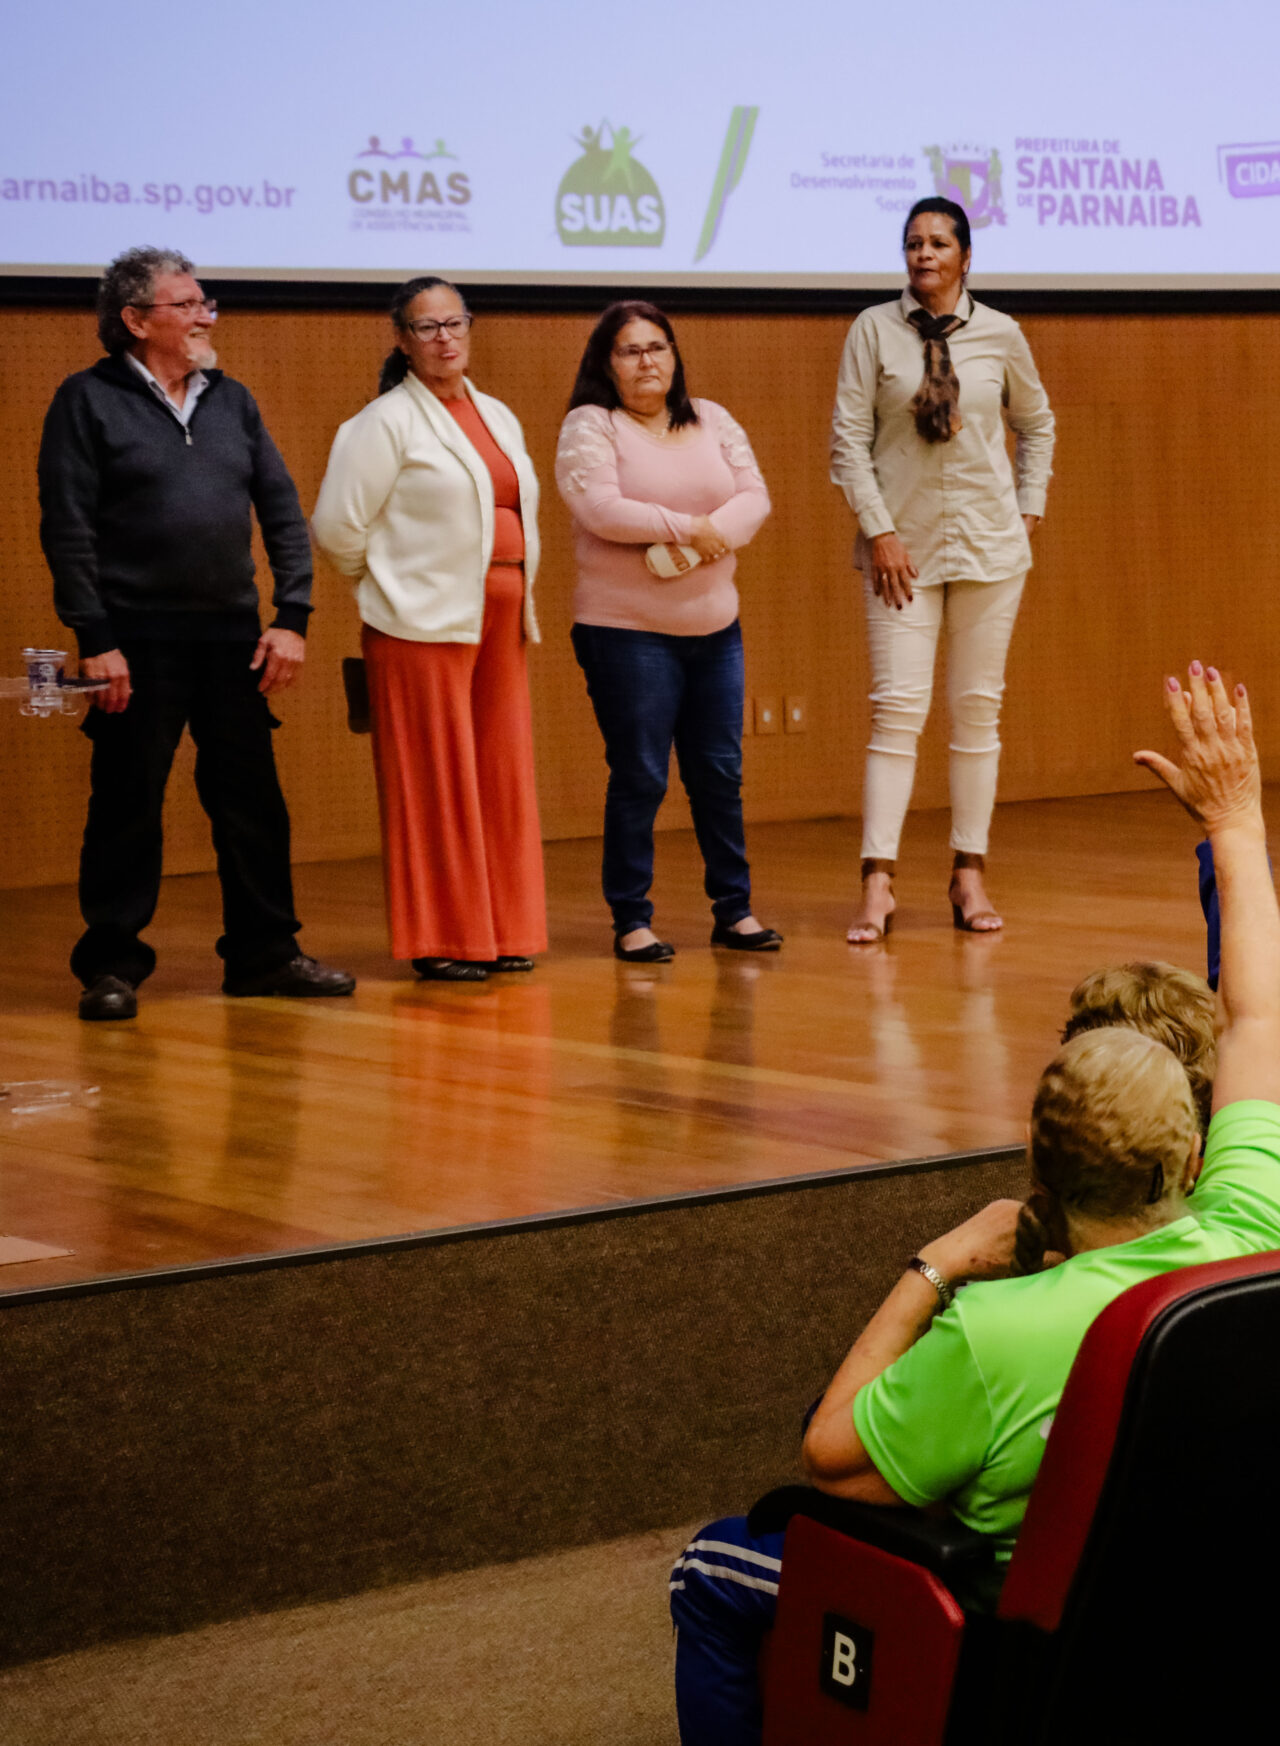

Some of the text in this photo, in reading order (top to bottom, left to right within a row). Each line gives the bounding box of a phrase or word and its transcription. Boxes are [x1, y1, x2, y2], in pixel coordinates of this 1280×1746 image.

[820, 151, 915, 169] Secretaria de
[1015, 137, 1121, 154] PREFEITURA DE
[348, 168, 472, 206] CMAS
[790, 171, 918, 190] Desenvolvimento
[1016, 156, 1165, 190] SANTANA
[0, 174, 295, 214] arnaiba.sp.gov.br
[1016, 186, 1202, 227] DE PARNAÍBA
[560, 192, 662, 235] SUAS
[833, 1631, 856, 1686] B
